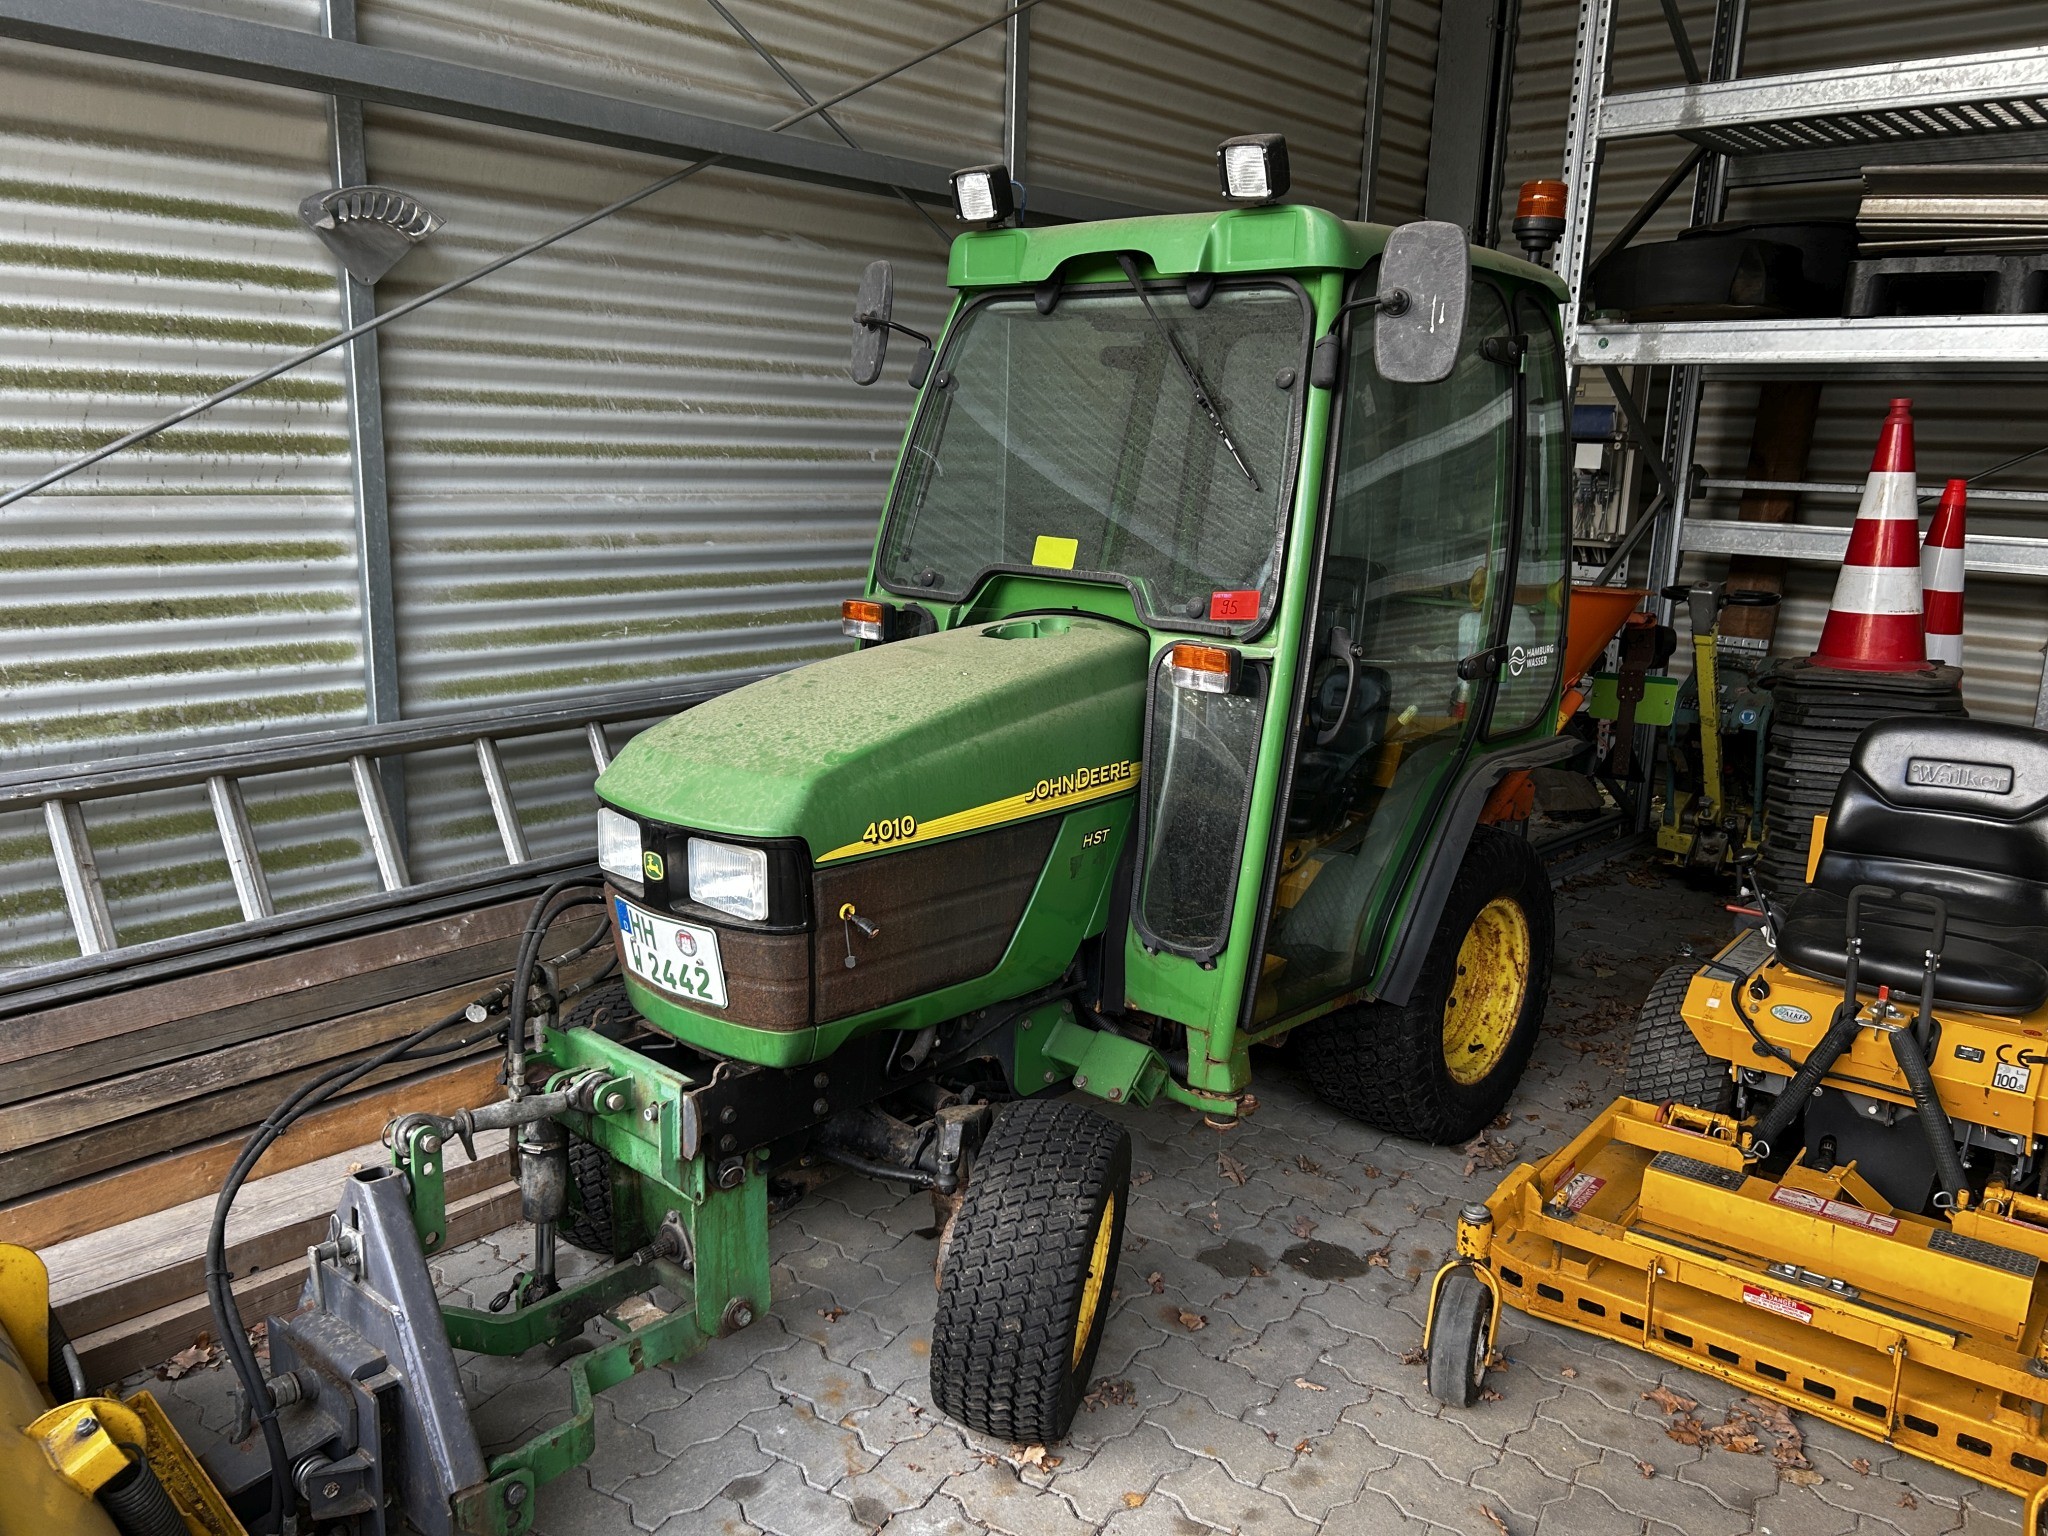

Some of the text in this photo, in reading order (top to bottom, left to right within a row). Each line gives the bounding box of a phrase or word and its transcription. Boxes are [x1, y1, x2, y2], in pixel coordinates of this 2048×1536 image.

[1220, 600, 1238, 615] 95
[1527, 644, 1554, 658] HAMBURG
[1527, 656, 1547, 668] WASSER
[1025, 760, 1131, 803] JOHN DEERE
[1911, 763, 2008, 791] Walker
[862, 815, 917, 843] 4010
[1082, 828, 1111, 849] HST
[623, 920, 629, 931] D
[628, 909, 658, 951] HH
[630, 941, 713, 1000] W 2442
[1774, 1006, 1809, 1022] WALKER
[1996, 1073, 2018, 1089] 100
[1571, 1185, 1597, 1209] DANGER
[1768, 1294, 1798, 1309] DANGER
